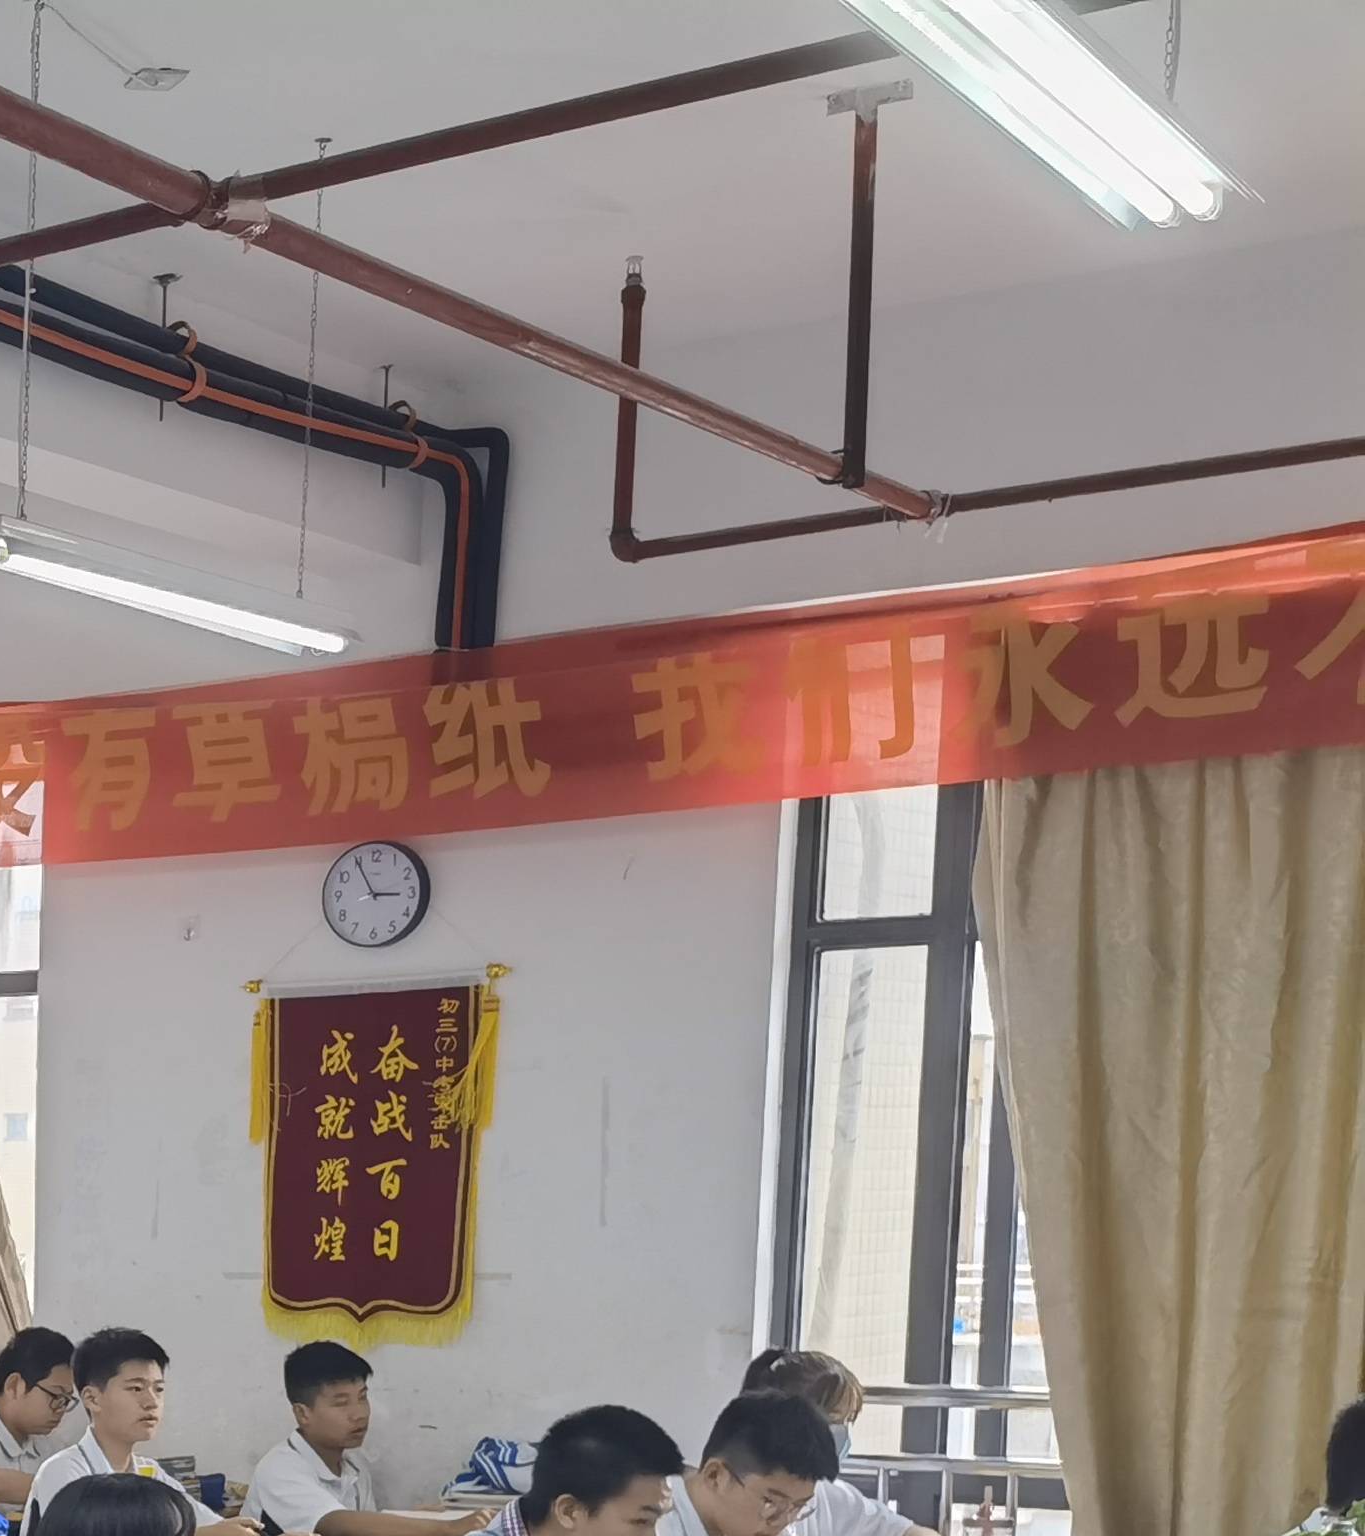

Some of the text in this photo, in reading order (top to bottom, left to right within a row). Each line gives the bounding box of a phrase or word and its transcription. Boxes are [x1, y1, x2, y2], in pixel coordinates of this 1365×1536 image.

[372, 849, 382, 863] 12
[340, 871, 350, 884] 10
[403, 867, 412, 880] 2
[334, 890, 342, 903] 9
[407, 886, 416, 899] 3
[339, 909, 347, 922] 8
[402, 905, 411, 918] 4
[351, 922, 359, 935] 7
[369, 927, 378, 940] 6
[388, 920, 397, 934] 5
[312, 1027, 360, 1264] 成就辉煌
[365, 1024, 421, 1264] 奋战百日
